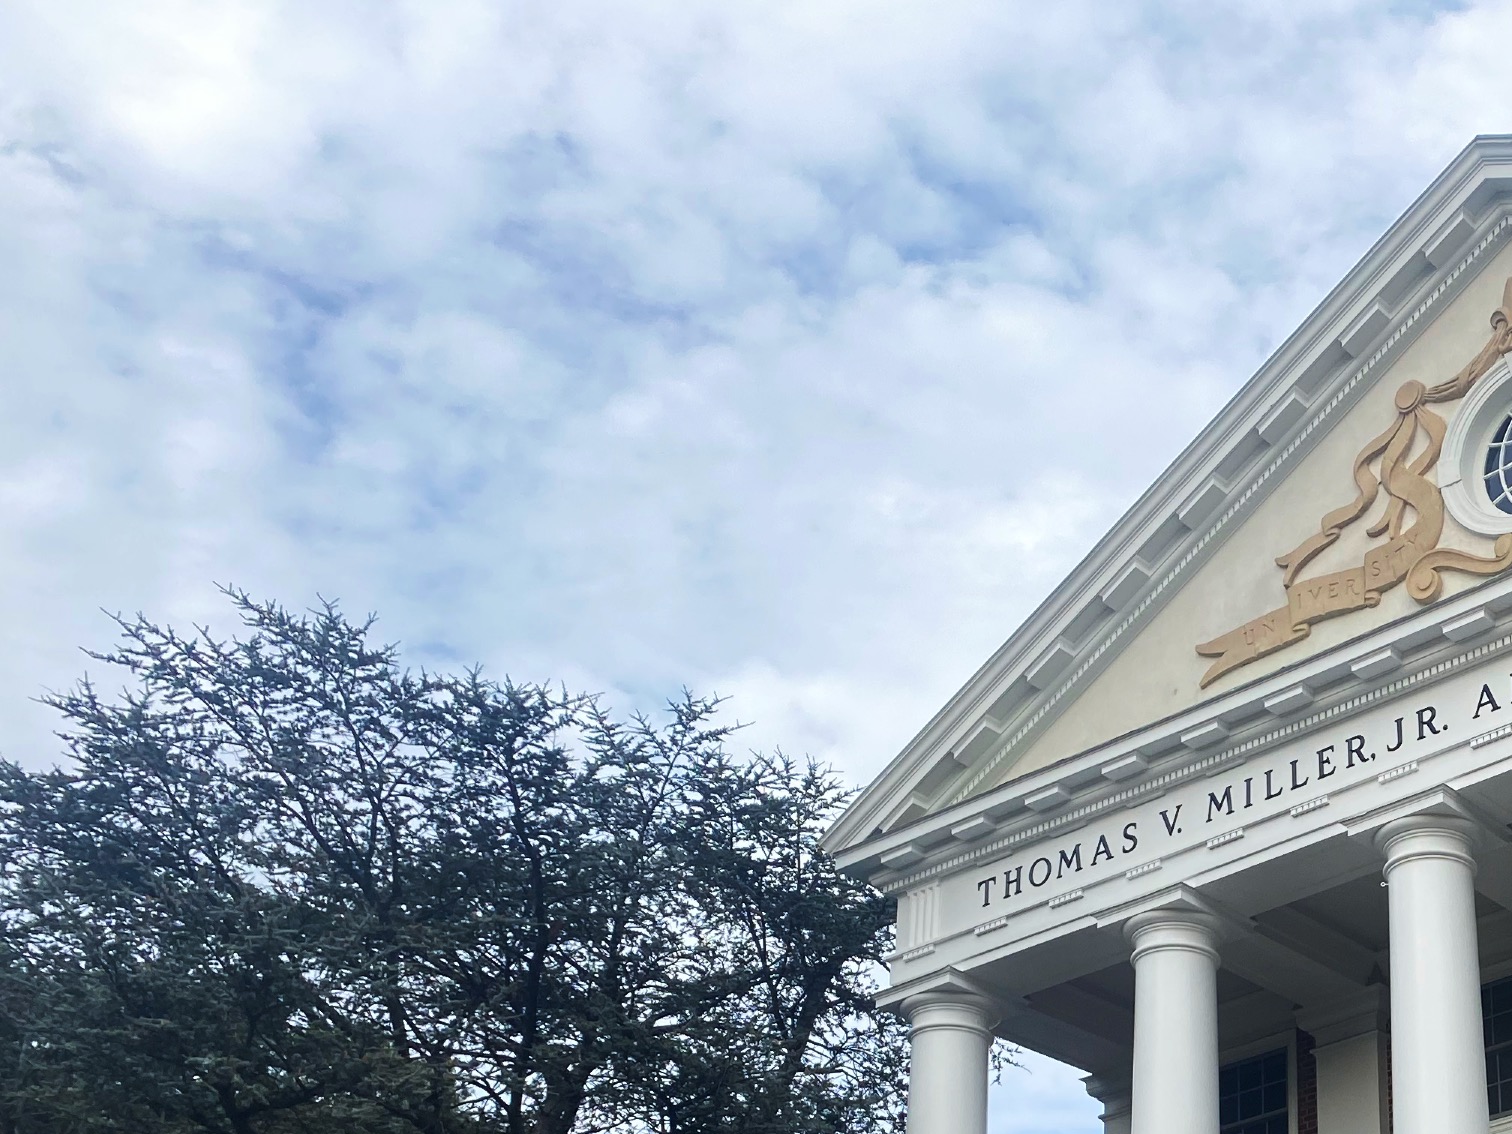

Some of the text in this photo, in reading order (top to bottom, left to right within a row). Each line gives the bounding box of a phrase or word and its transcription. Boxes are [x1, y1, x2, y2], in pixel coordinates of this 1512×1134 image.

[977, 822, 1139, 908] THOMAS
[1159, 804, 1183, 838] V.
[1205, 732, 1377, 824] MILLER,
[1385, 704, 1449, 753] JR.
